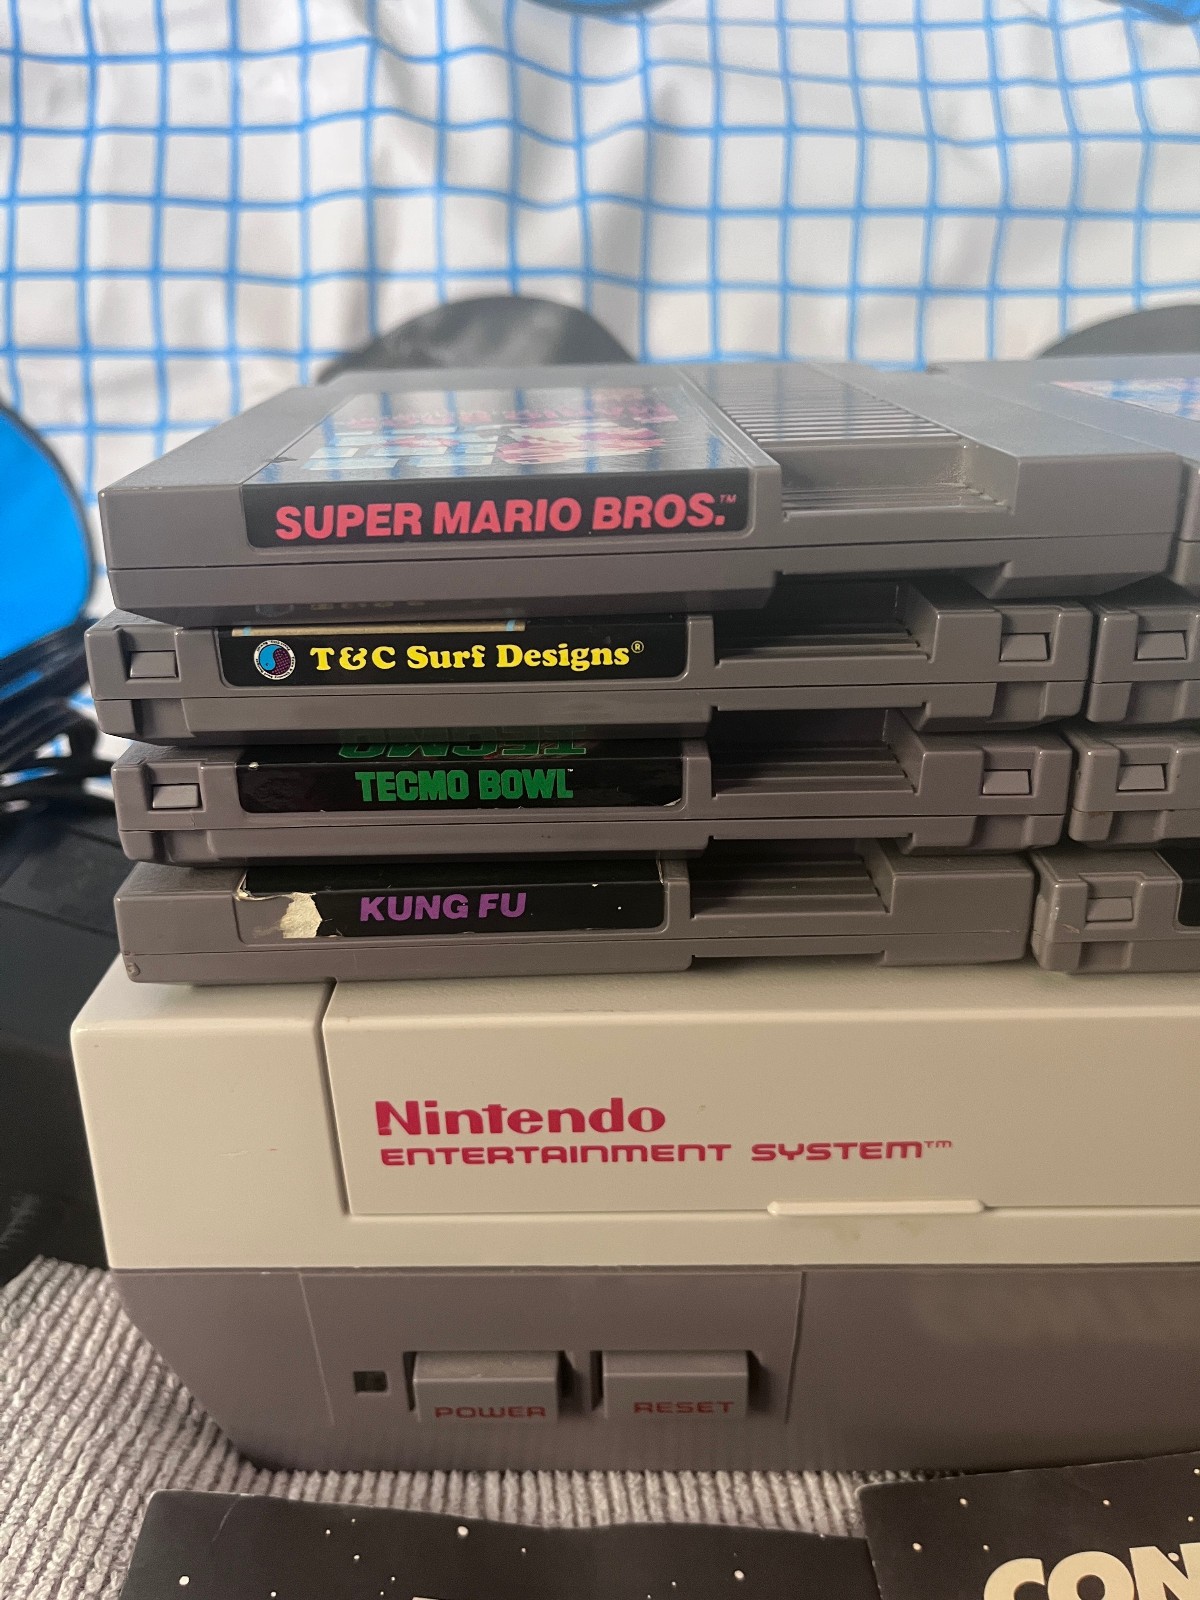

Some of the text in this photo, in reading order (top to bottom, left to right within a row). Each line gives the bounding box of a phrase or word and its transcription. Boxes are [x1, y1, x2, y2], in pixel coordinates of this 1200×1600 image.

[275, 501, 423, 541] SUPER
[433, 496, 582, 536] MARIO
[309, 645, 396, 671] T&C
[406, 643, 485, 669] Surf
[354, 769, 470, 802] TECMO
[359, 892, 527, 922] KUNG FU
[375, 1097, 666, 1137] Nintendo
[380, 1143, 732, 1167] ENTERTAINMENT
[434, 1405, 547, 1419] POWER
[633, 1400, 735, 1414] RESET
